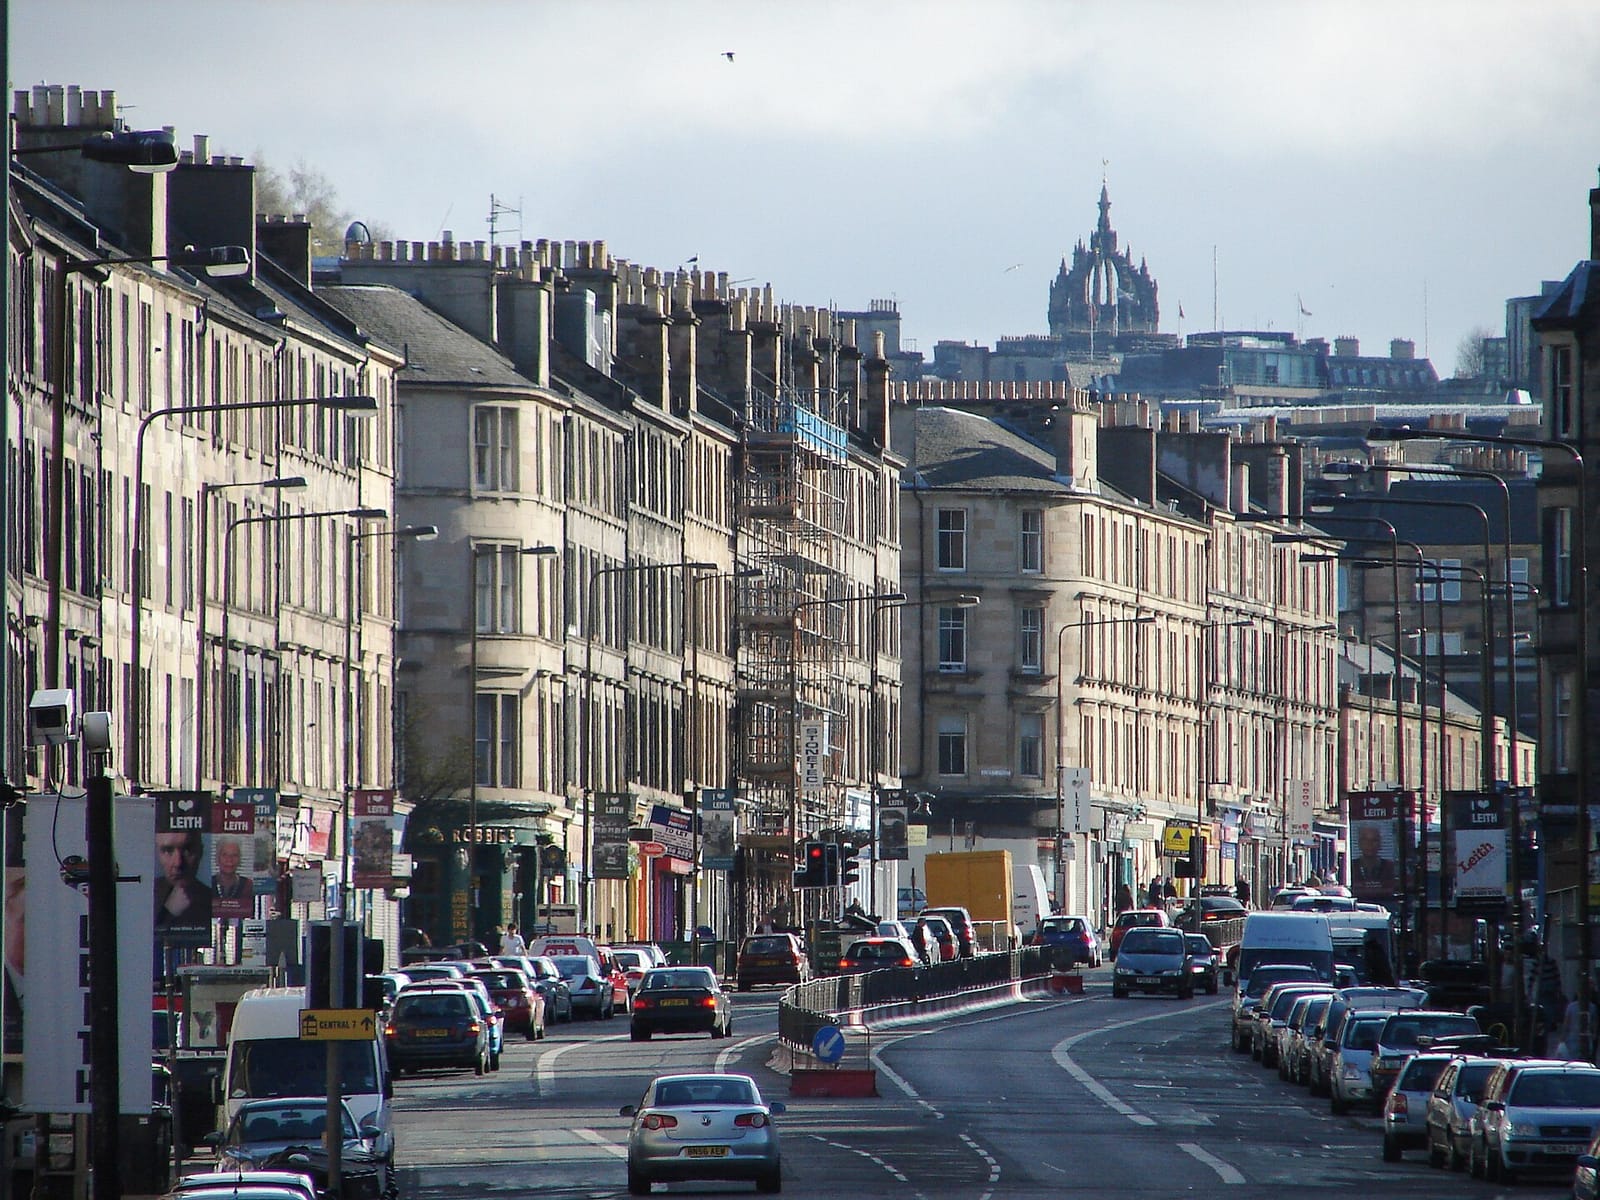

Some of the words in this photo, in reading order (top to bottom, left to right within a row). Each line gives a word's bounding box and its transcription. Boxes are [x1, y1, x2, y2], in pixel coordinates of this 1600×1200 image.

[1364, 808, 1386, 817] LEITH
[1472, 812, 1498, 823] LEITH
[170, 816, 203, 829] LEITH
[224, 821, 249, 831] LEITH
[675, 830, 688, 838] LET
[1458, 842, 1495, 874] Leith
[319, 1021, 350, 1029] CENTRAL
